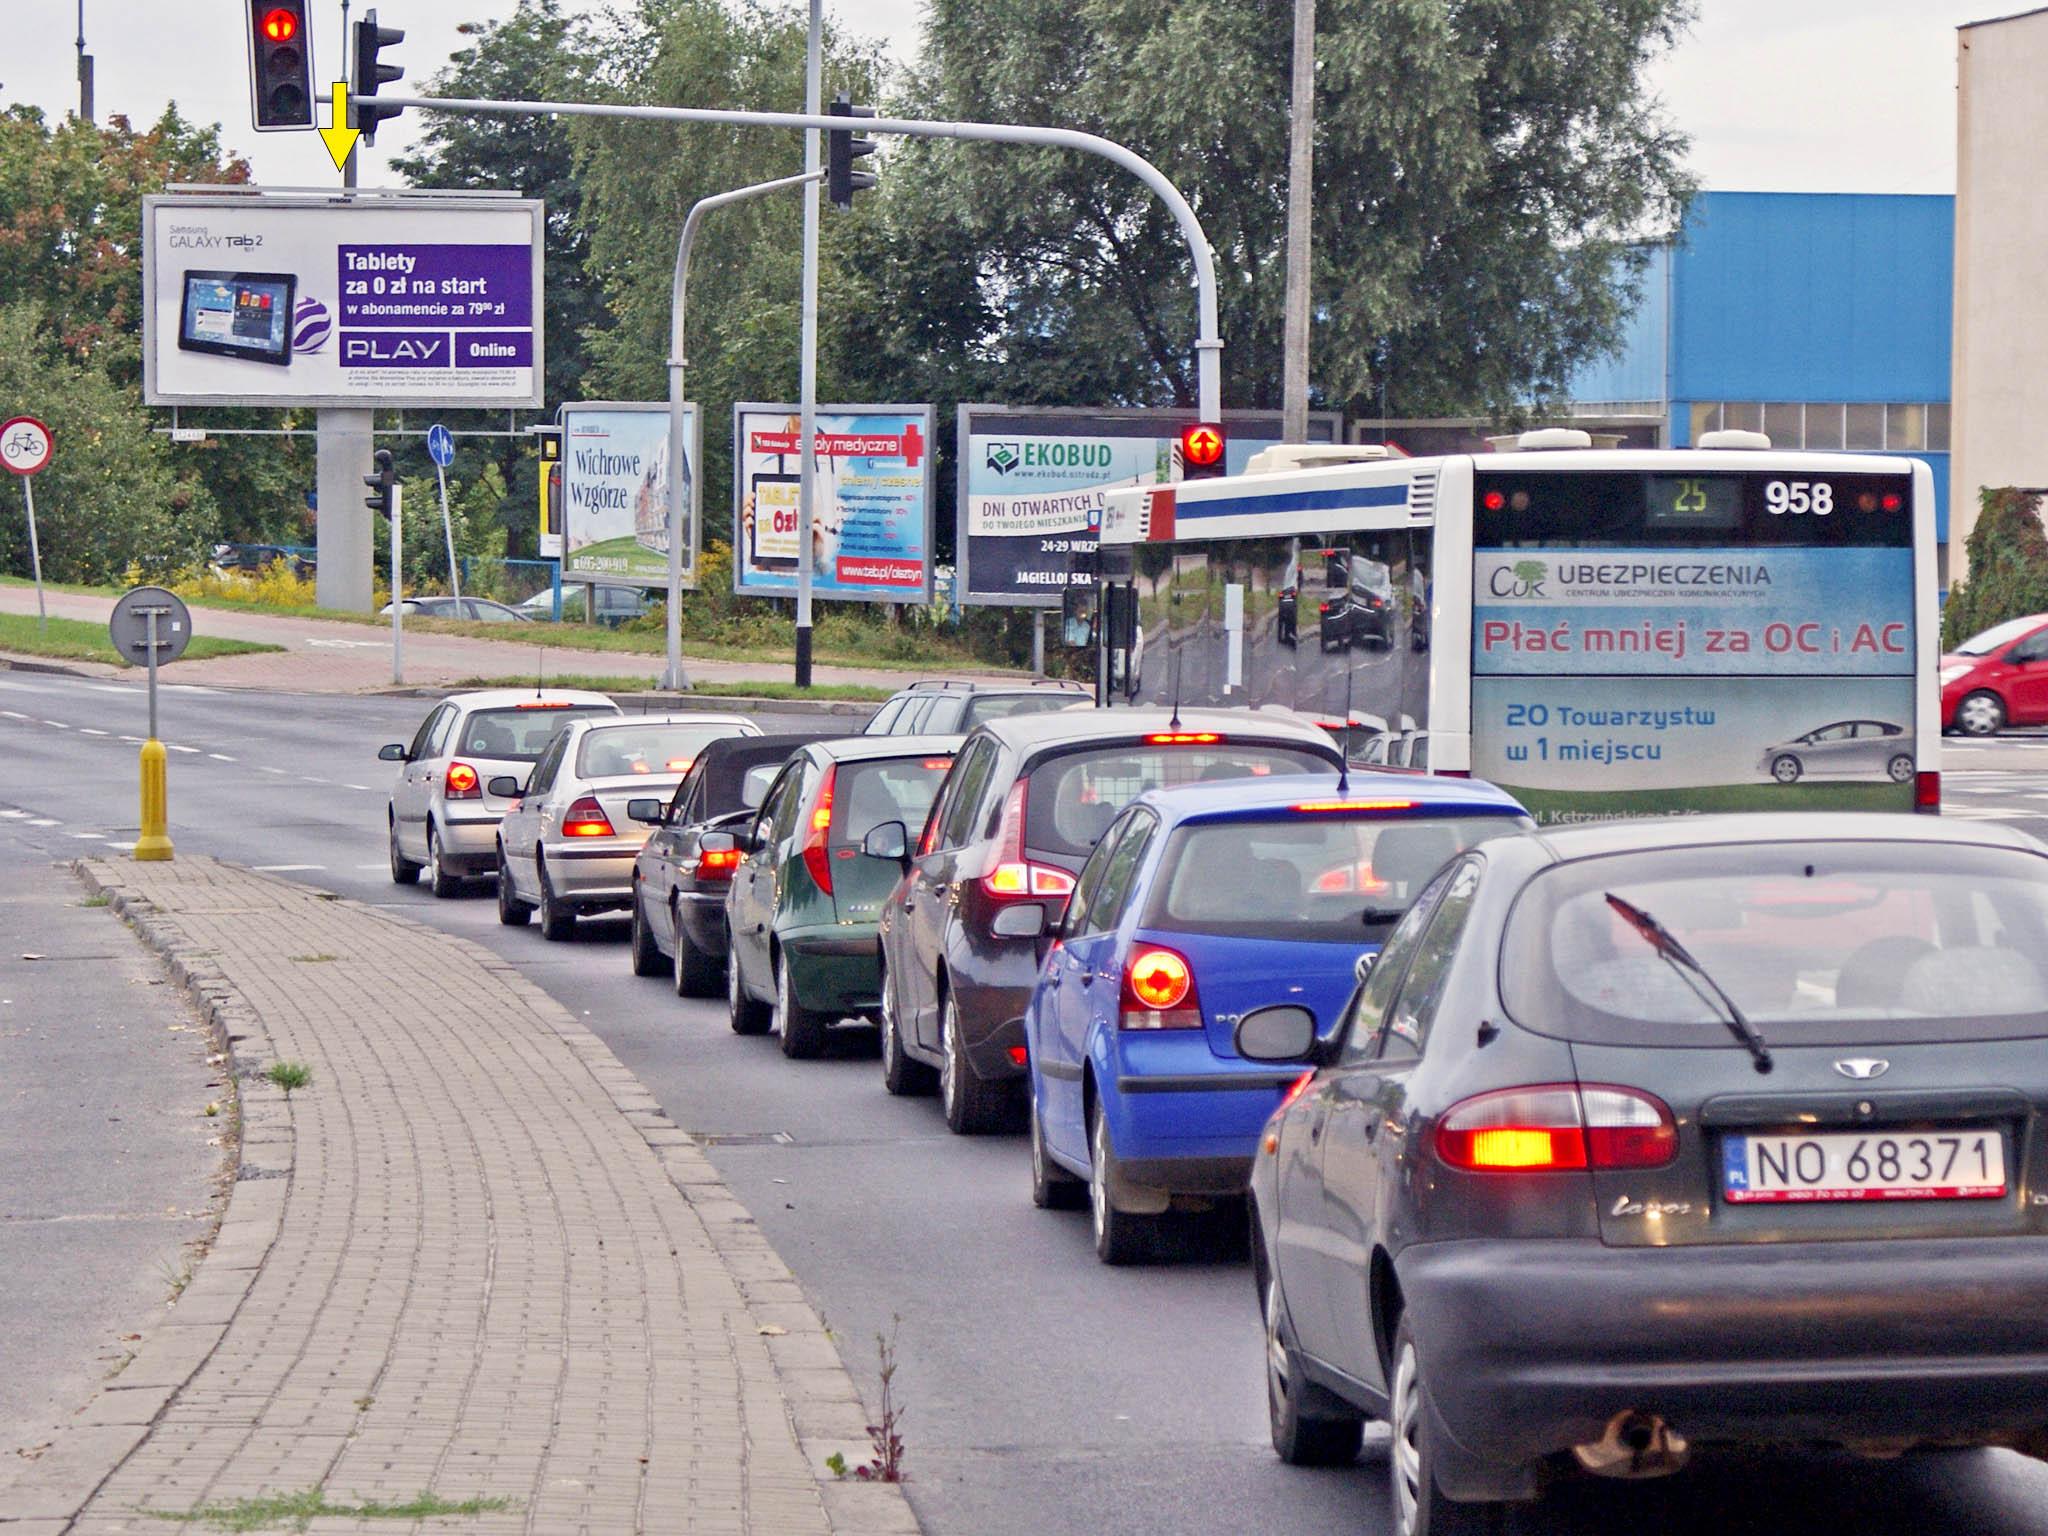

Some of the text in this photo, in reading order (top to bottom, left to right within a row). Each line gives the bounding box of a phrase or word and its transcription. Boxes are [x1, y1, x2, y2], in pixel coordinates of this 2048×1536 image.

[170, 225, 208, 234] Samsung
[170, 235, 263, 248] GALAXY Tab 2
[346, 252, 416, 274] Tablety
[346, 277, 487, 295] za 0 zł na start
[347, 305, 358, 314] w
[361, 302, 448, 315] abonamencie
[451, 305, 465, 315] za
[494, 302, 505, 315] zł
[347, 340, 516, 359] PLAY Online
[833, 438, 897, 454] medyczne
[1025, 443, 1112, 467] EKOBUD
[576, 448, 640, 476] Wichrowe
[571, 481, 627, 515] Wzgórze
[983, 502, 1006, 516] DNI
[1012, 495, 1091, 516] OTWARTYCH
[1674, 479, 1707, 512] 25
[1766, 481, 1834, 515] 958
[983, 516, 1088, 529] DO TWOJEGO MIESZKANIA
[1041, 540, 1099, 552] 24-29 WRZE
[1558, 565, 1771, 584] UBEZPIECZENIA
[1485, 622, 1904, 658] Płać mniej za OC i AC
[1507, 704, 1715, 729] 20 Towarzystw
[1507, 738, 1661, 764] w 1 miejscu
[1757, 1138, 1988, 1185] NO 68371
[1729, 1171, 1747, 1184] PL
